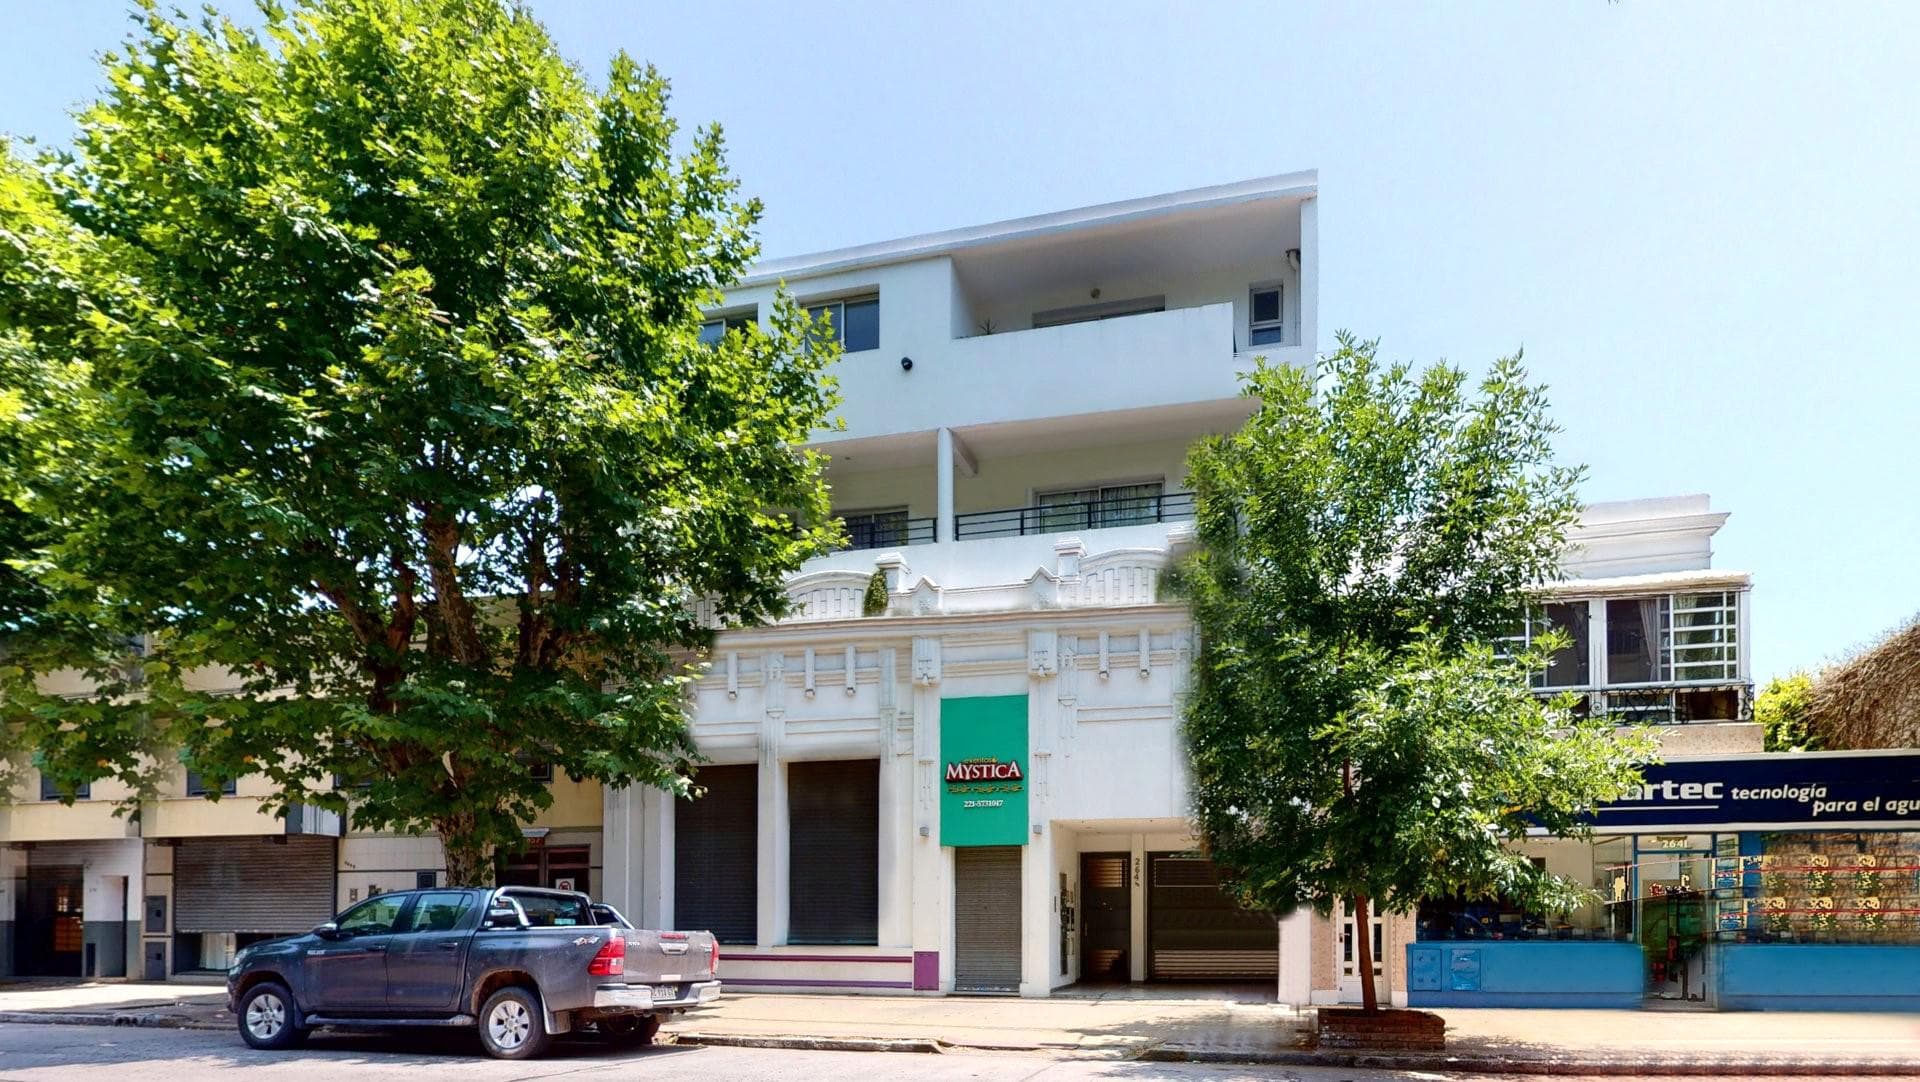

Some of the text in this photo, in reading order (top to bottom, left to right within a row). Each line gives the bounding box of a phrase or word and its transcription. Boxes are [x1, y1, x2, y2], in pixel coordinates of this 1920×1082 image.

[946, 760, 1021, 780] MYSTICA
[1731, 784, 1827, 802] tecnología
[1812, 800, 1857, 816] para
[1863, 797, 1881, 811] el
[1661, 839, 1689, 849] 2641
